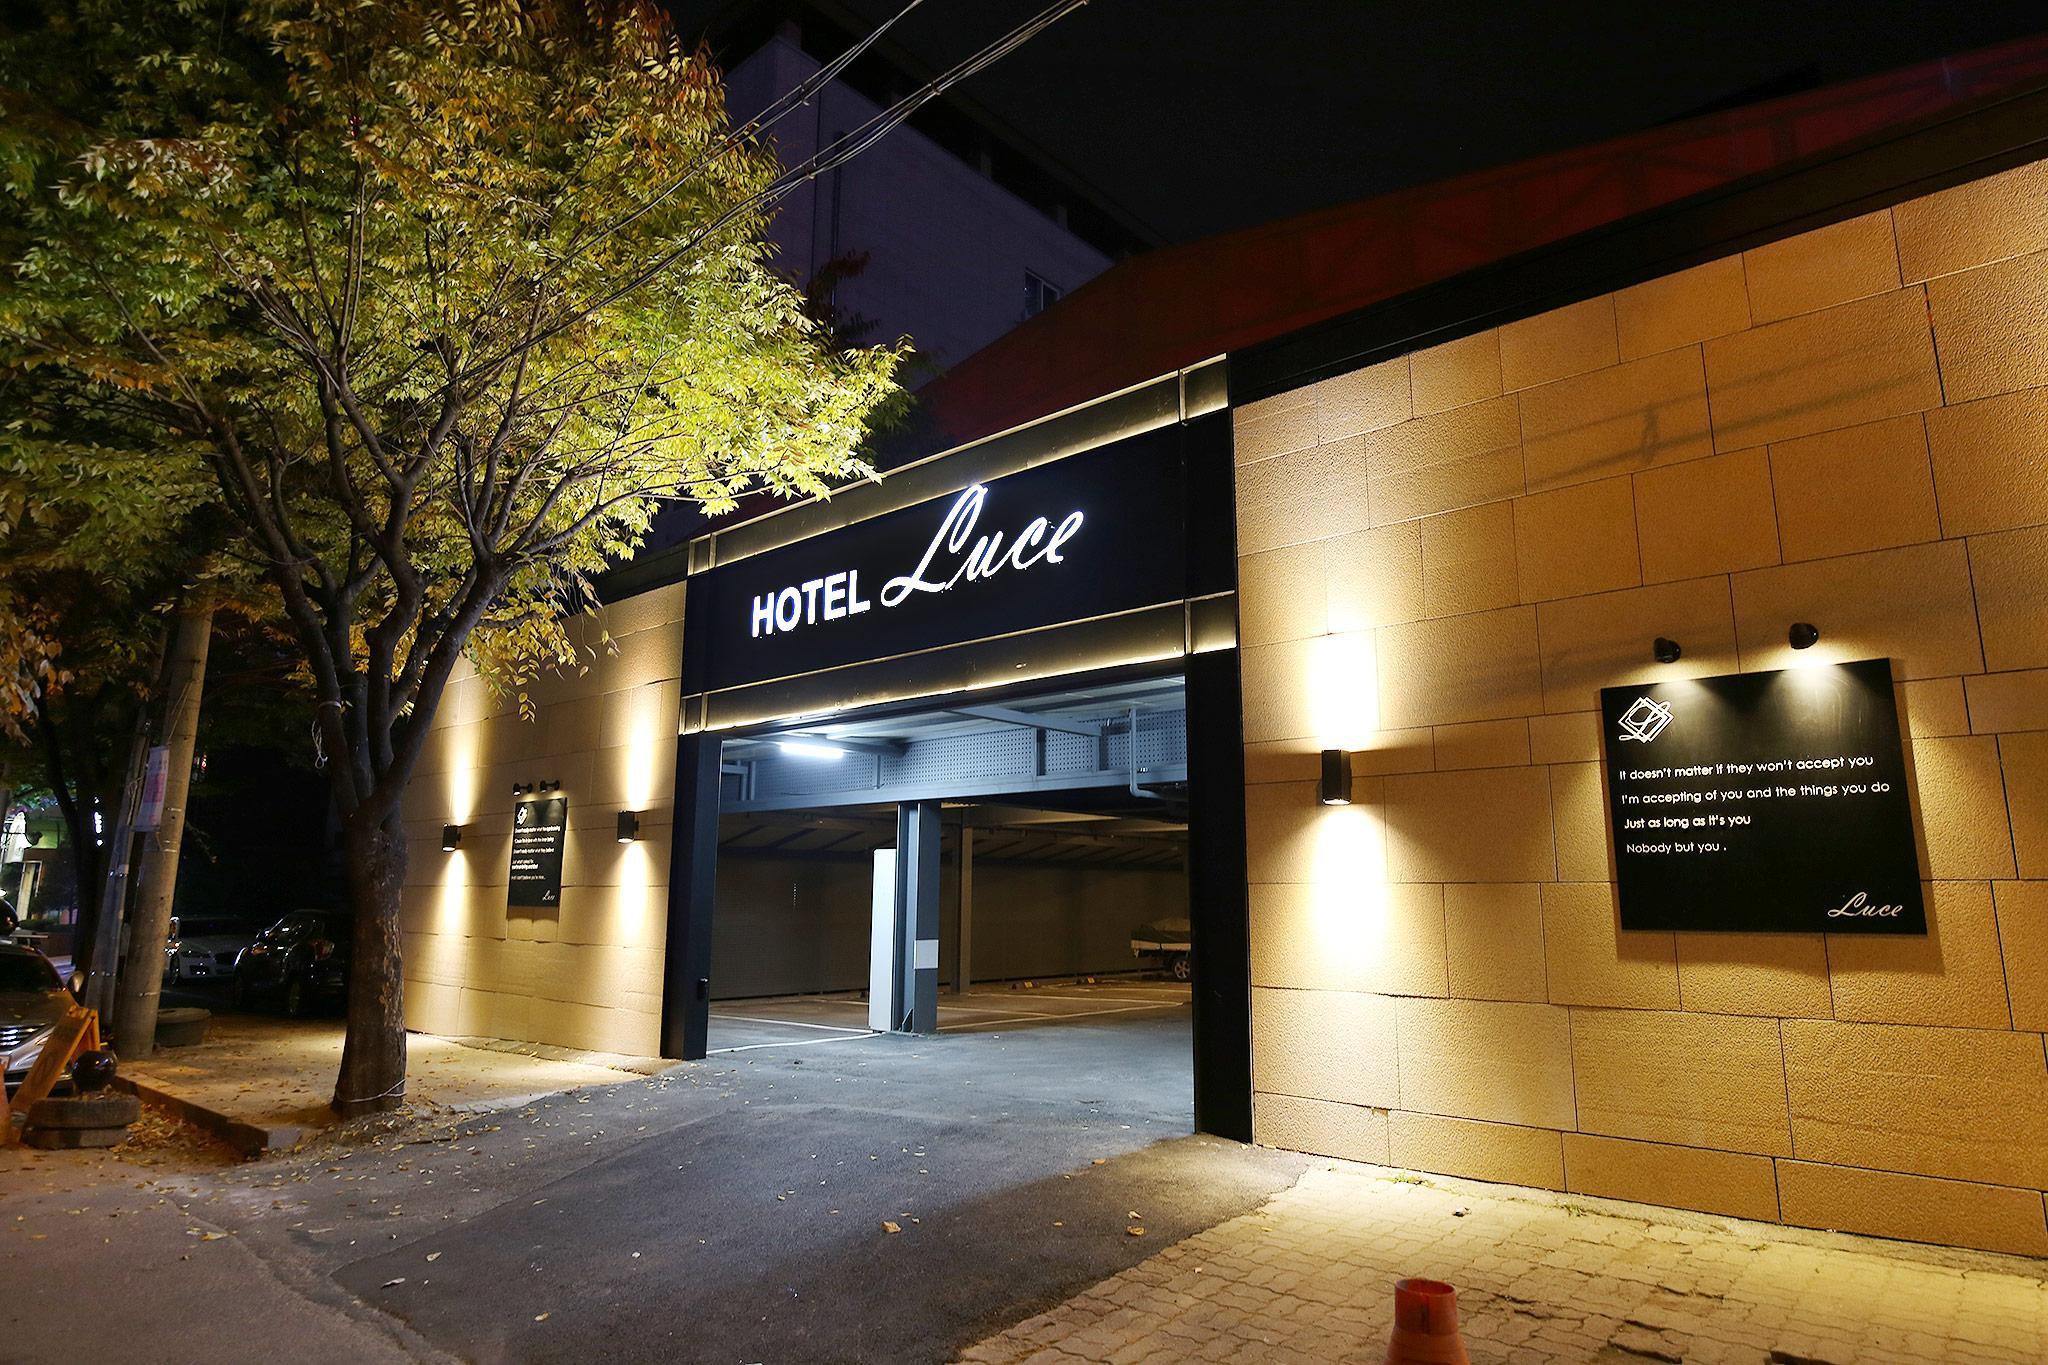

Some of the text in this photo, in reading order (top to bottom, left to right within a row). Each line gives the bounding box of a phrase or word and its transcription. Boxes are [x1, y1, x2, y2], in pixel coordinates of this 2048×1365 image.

[752, 484, 1084, 637] HOTEL Luce
[1619, 770, 1626, 780] It
[1629, 767, 1672, 780] doesn't
[1674, 765, 1714, 778] matter
[1726, 763, 1754, 775] they
[1756, 759, 1793, 772] won't
[1795, 756, 1845, 770] accept
[1847, 756, 1874, 769] you
[1621, 781, 1890, 804] I'm accepting of you and the things you do
[1624, 818, 1646, 829] Just
[1647, 818, 1661, 828] as
[1663, 817, 1690, 829] long
[1692, 817, 1706, 827] as
[1727, 815, 1751, 827] you
[1626, 842, 1672, 854] Nobody
[1674, 841, 1695, 852] but
[1697, 843, 1720, 854] you
[1827, 891, 1904, 917] Luce
